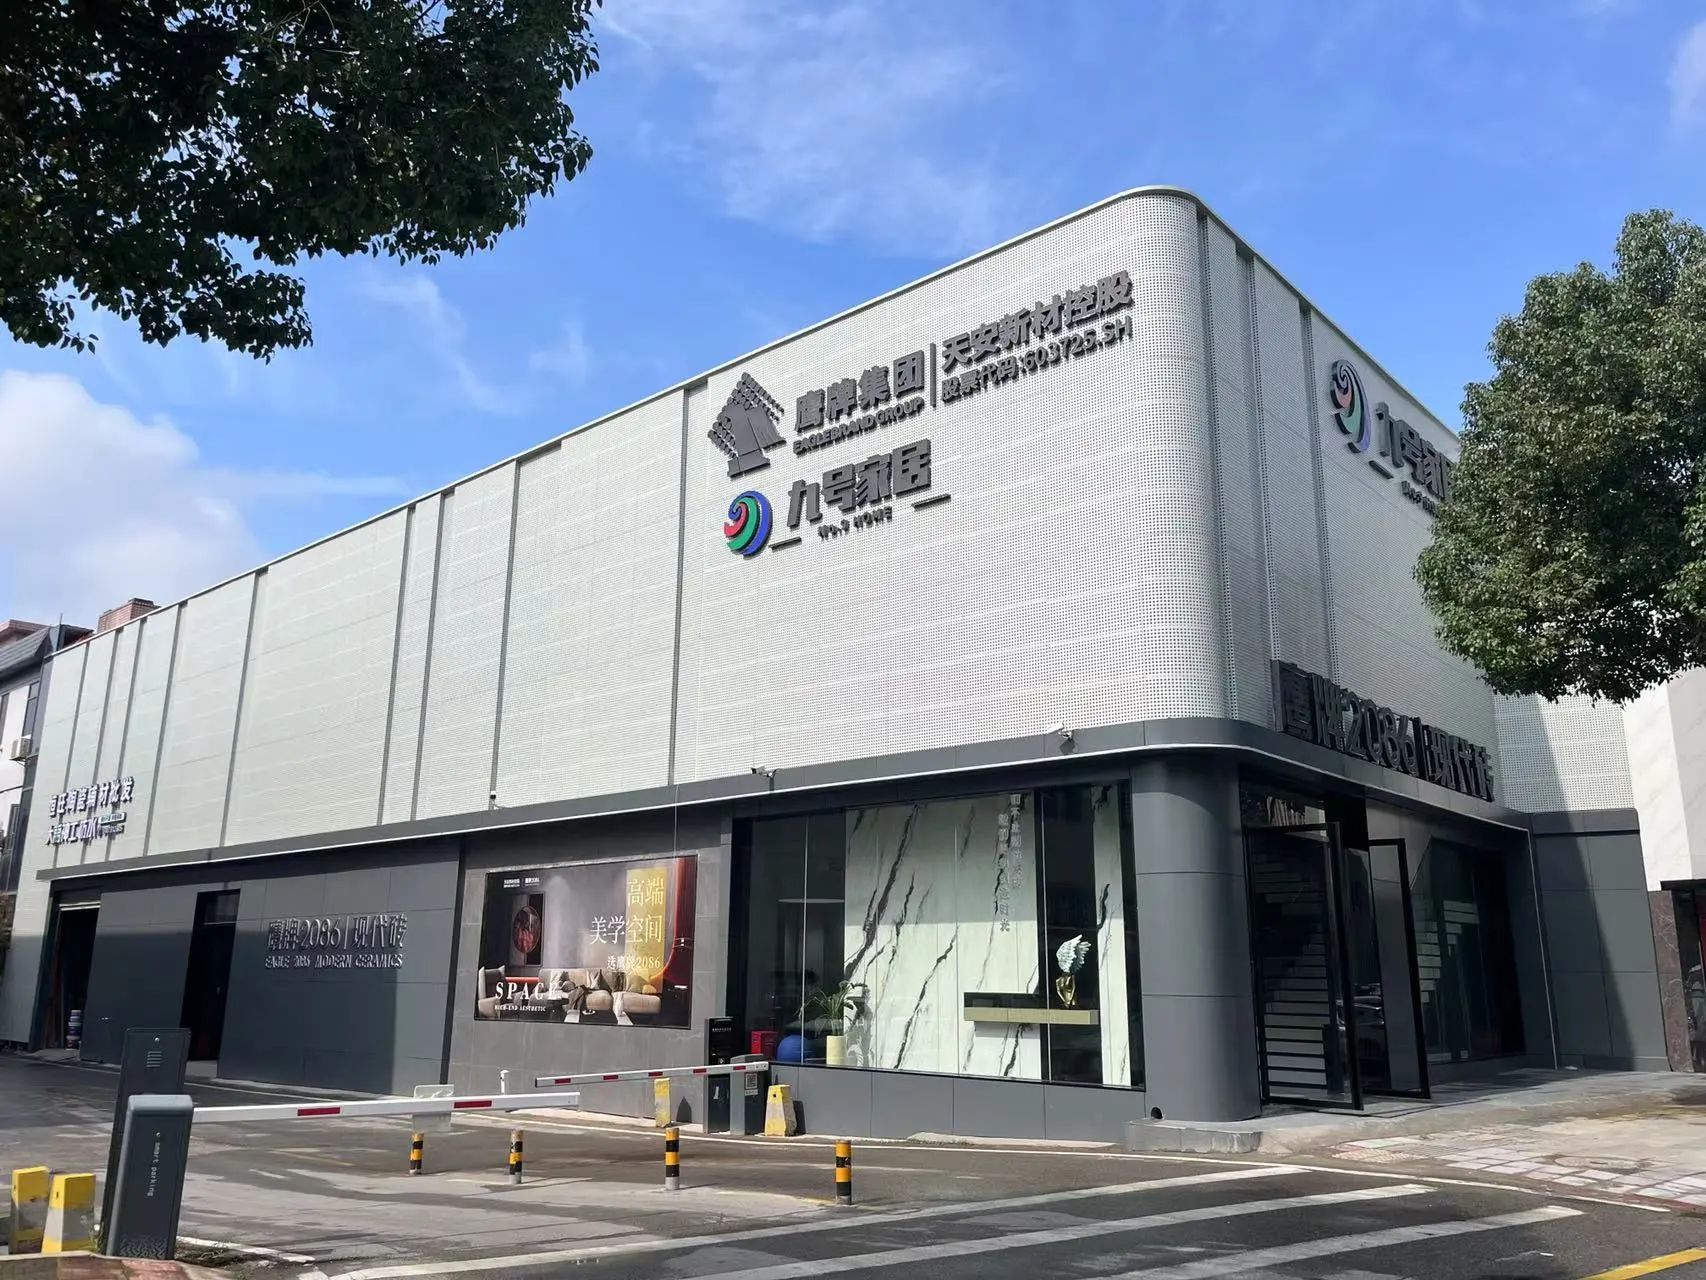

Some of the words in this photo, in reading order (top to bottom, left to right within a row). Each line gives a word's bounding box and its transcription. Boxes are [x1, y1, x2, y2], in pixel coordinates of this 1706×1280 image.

[942, 270, 1134, 372] 天安新材控股
[794, 349, 925, 433] 鹰牌集团
[876, 396, 925, 427] GROUP
[787, 438, 931, 530] 九号家居
[853, 506, 892, 530] HOME
[627, 877, 664, 907] 高端
[590, 914, 663, 945] 美学空间
[315, 954, 352, 968] MODERN
[355, 953, 403, 968] CERAMICS
[495, 981, 562, 1000] SPACE
[147, 1166, 157, 1196] parking
